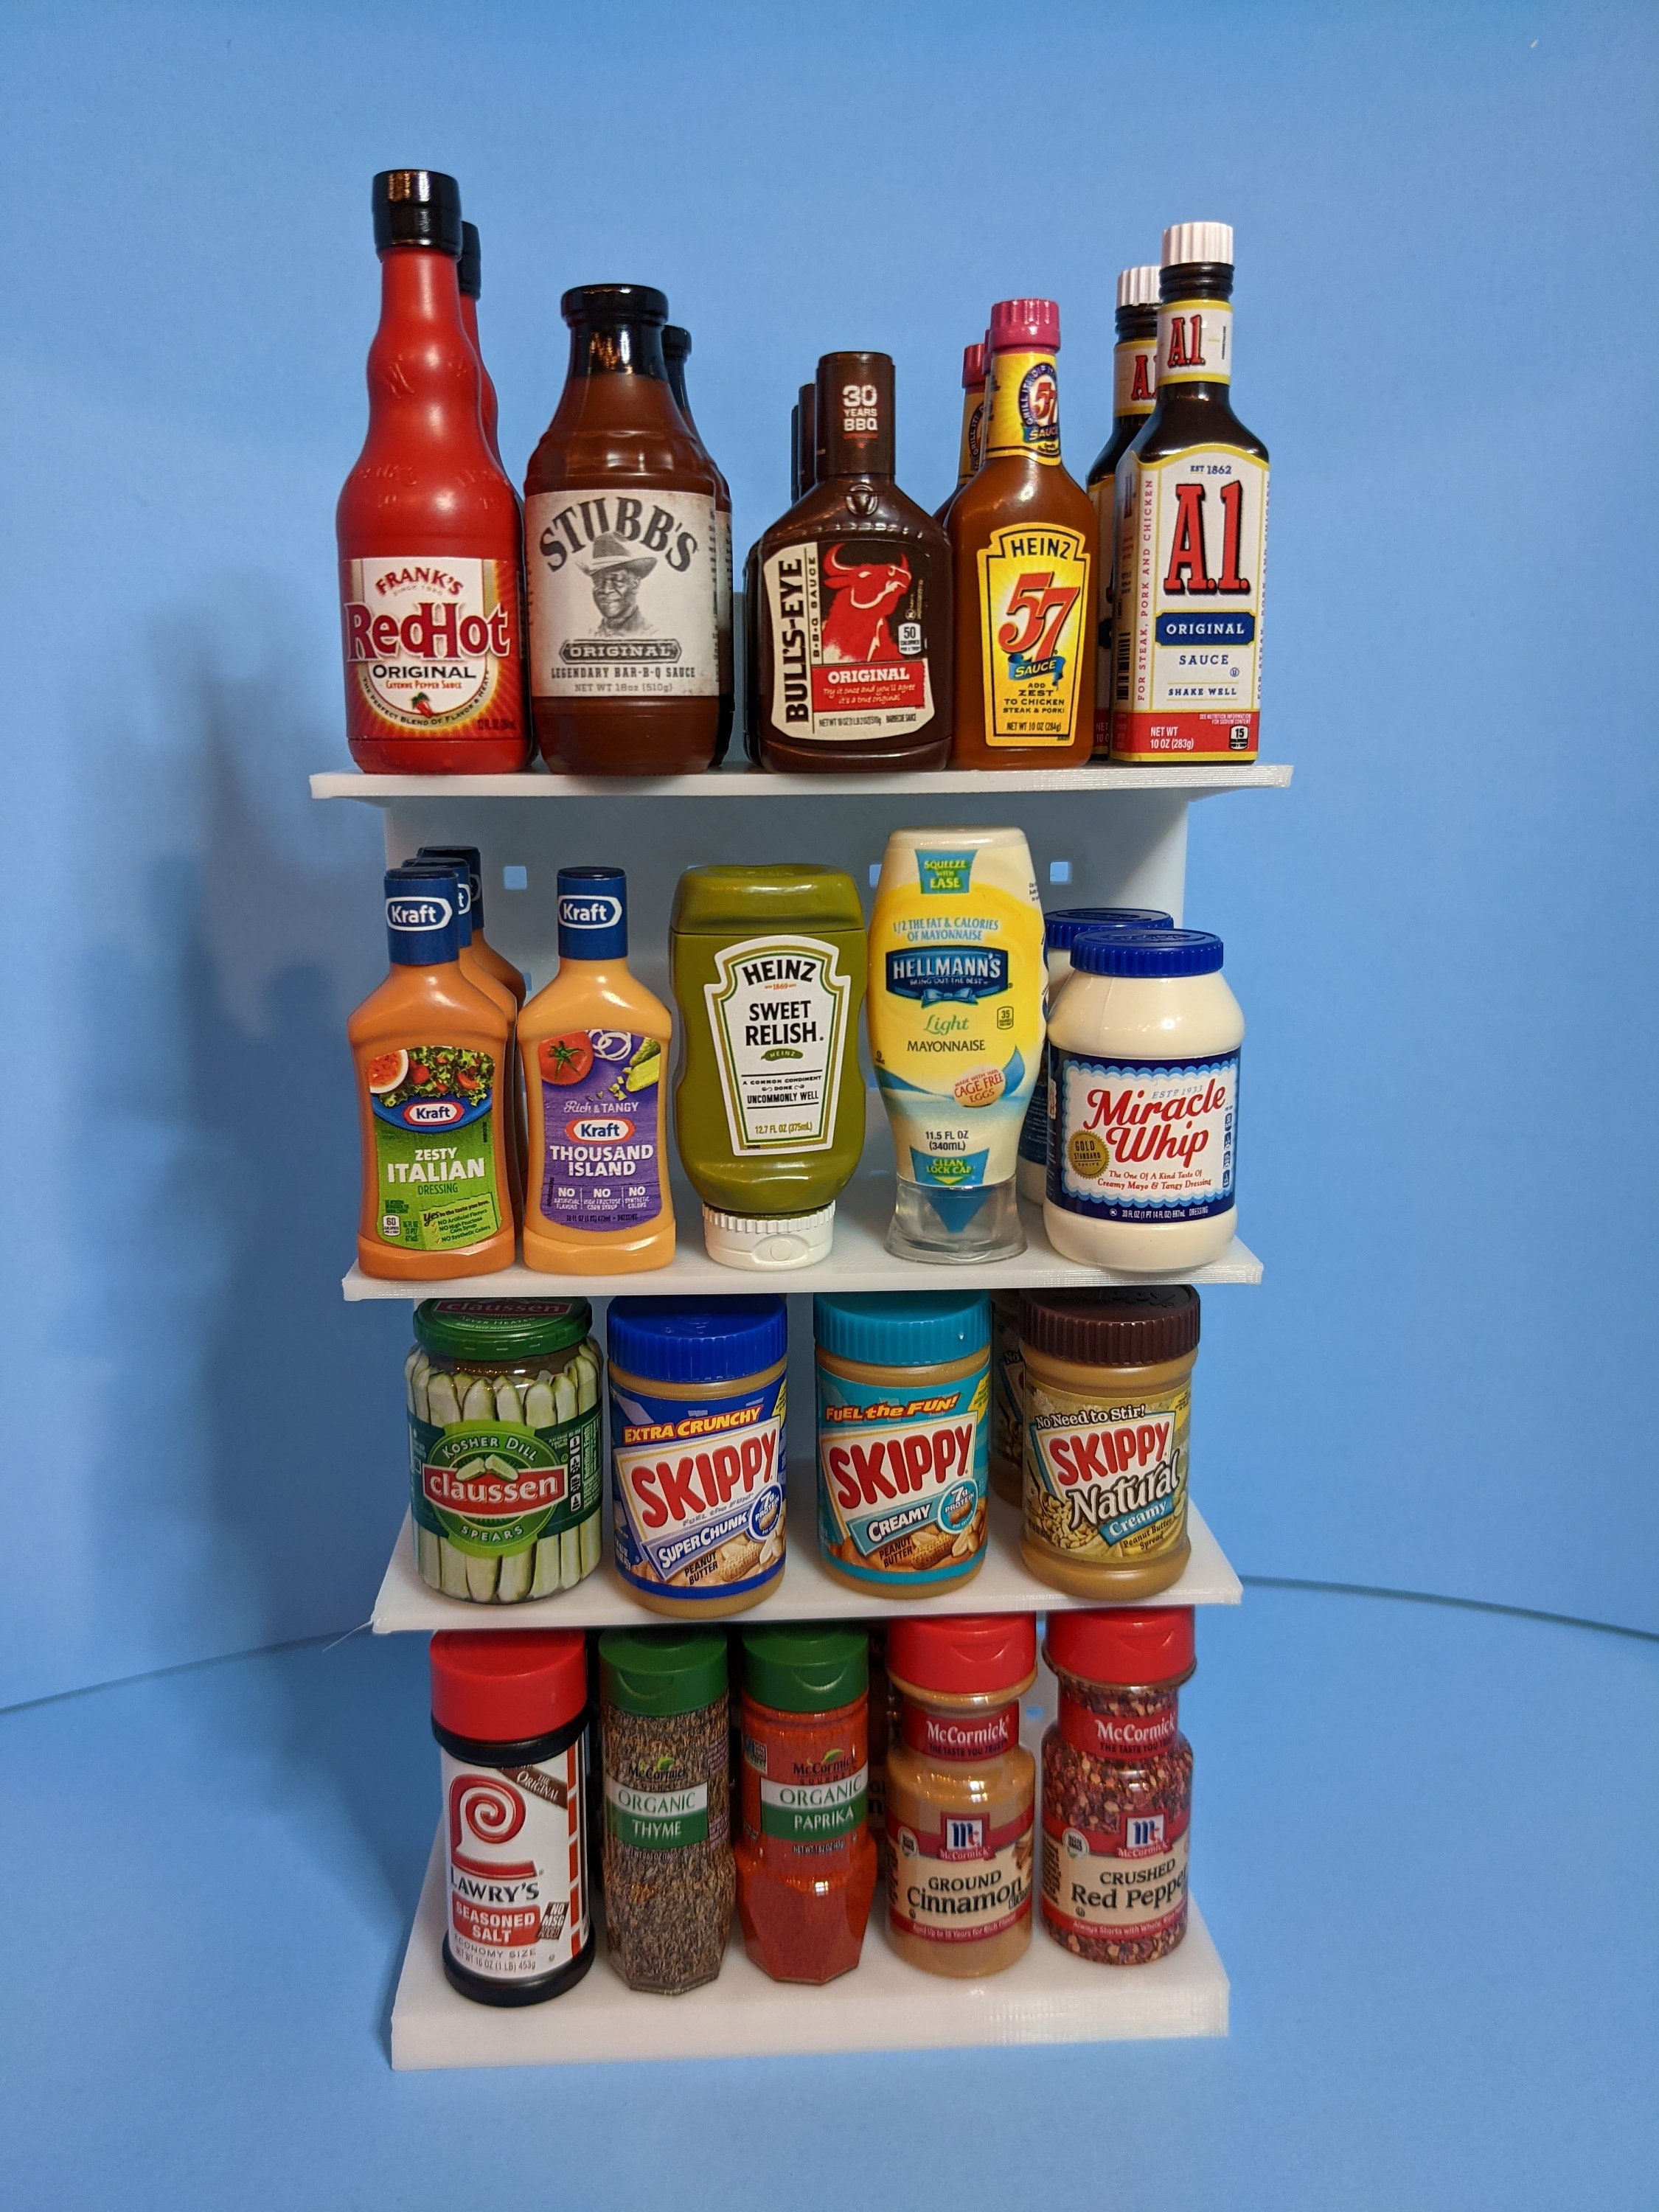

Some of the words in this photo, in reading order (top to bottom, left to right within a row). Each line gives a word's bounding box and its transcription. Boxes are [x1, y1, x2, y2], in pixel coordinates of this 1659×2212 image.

[842, 384, 877, 407] 30
[843, 408, 878, 417] YEARS
[844, 417, 878, 431] BBQ
[1206, 465, 1231, 475] 1862
[1144, 480, 1153, 541] CHICKEN
[539, 496, 699, 574] STUBB'S
[1011, 538, 1071, 559] HEINZ
[1142, 549, 1151, 575] AND
[375, 567, 464, 597] FRANK'S
[1141, 582, 1150, 617] PORK
[998, 571, 1081, 662] 57
[345, 602, 510, 661] RedHot
[903, 627, 916, 639] 50
[1166, 623, 1245, 635] ORIGINAL
[779, 558, 810, 723] BULL'S-EYE
[1138, 624, 1149, 670] STEAK,
[569, 644, 672, 658] ORIGINAL
[1179, 655, 1230, 665] SAUCE
[373, 664, 476, 678] ORIGINAL
[551, 667, 609, 679] LEGENDARY
[614, 667, 661, 679] BAR-B-Q
[666, 667, 696, 678] SAUCE
[827, 667, 911, 684] ORIGINAL
[1015, 660, 1057, 678] SAUCE
[1138, 677, 1146, 701] FOR
[1168, 688, 1203, 696] SHAKE
[1208, 688, 1237, 696] WELL
[1150, 726, 1165, 737] NET
[1166, 726, 1178, 737] WT
[1235, 728, 1245, 738] 15
[1150, 740, 1158, 749] 10
[1160, 739, 1170, 749] OZ
[1171, 738, 1194, 750] (283g)
[924, 860, 967, 869] SQUEEZE
[930, 878, 961, 888] EASE
[392, 905, 437, 923] Kraft
[563, 902, 607, 921] Kraft
[894, 921, 906, 933] 1/2
[908, 919, 925, 929] THE
[926, 917, 942, 928] FAT
[945, 918, 952, 928] &
[955, 917, 999, 931] CALORIES
[908, 931, 920, 942] OF
[922, 930, 982, 941] MAYONNAISE
[742, 959, 817, 986] HEINZ
[893, 952, 1001, 980] HELLMANN'S
[749, 1000, 811, 1021] SWEET
[1001, 1010, 1010, 1018] 35
[923, 1015, 970, 1035] Light
[769, 1050, 797, 1058] HEINZ
[907, 1040, 986, 1052] MAYONNAISE
[954, 1082, 981, 1098] CAGE
[983, 1073, 1004, 1091] FREE
[747, 1093, 798, 1104] UNCOMMONLY
[800, 1091, 818, 1101] WELL
[969, 1088, 995, 1103] EGGS
[1083, 1079, 1225, 1130] Miracle
[416, 1106, 451, 1121] Kraft
[563, 1101, 591, 1113] Rich
[594, 1105, 600, 1113] &
[601, 1102, 639, 1113] TANGY
[580, 1123, 620, 1137] Kraft
[925, 1131, 942, 1140] 11.5
[945, 1131, 955, 1140] FL
[958, 1130, 969, 1139] OZ
[550, 1144, 654, 1161] THOUSAND
[1075, 1141, 1095, 1151] GOLD
[1106, 1121, 1209, 1168] Whip
[415, 1147, 458, 1162] ZESTY
[933, 1159, 964, 1167] CLEAN
[1074, 1152, 1101, 1160] STANDARD
[387, 1158, 486, 1183] ITALIAN
[568, 1161, 636, 1176] ISLAND
[926, 1166, 950, 1174] LOCK
[952, 1166, 972, 1174] CAP
[1124, 1171, 1137, 1180] One
[1140, 1172, 1149, 1180] Of
[1178, 1171, 1193, 1179] Taste
[1194, 1169, 1203, 1178] Of
[418, 1183, 459, 1195] DRESSING
[558, 1187, 575, 1197] NO
[594, 1188, 611, 1197] NO
[629, 1186, 646, 1196] NO
[1098, 1178, 1125, 1190] Creamy
[1127, 1181, 1148, 1191] Mayo
[1161, 1181, 1183, 1190] Tangy
[1185, 1179, 1211, 1189] Dressing
[386, 1217, 397, 1225] 60
[447, 1301, 560, 1312] claussen
[827, 1405, 863, 1422] FUEL
[866, 1402, 903, 1419] the
[907, 1394, 958, 1416] FUN!
[1035, 1416, 1050, 1429] No
[1051, 1412, 1088, 1427] Need
[1091, 1411, 1108, 1422] to
[1110, 1405, 1146, 1420] Stir!
[625, 1426, 674, 1443] EXTRA
[678, 1407, 762, 1437] CRUNCHY
[443, 1437, 499, 1460] KOSHER
[506, 1437, 538, 1461] DILL
[1049, 1421, 1170, 1486] SKIPPY
[829, 1423, 973, 1509] SKIPPY
[430, 1472, 557, 1503] claussen
[631, 1429, 777, 1528] SKIPPY
[1068, 1449, 1180, 1530] Natural
[755, 1495, 779, 1521] PROTEIN
[945, 1492, 974, 1513] PROTEIN
[867, 1503, 933, 1543] CREAMY
[1109, 1500, 1166, 1537] Creamy
[461, 1526, 523, 1541] SPEARS
[1122, 1530, 1150, 1548] Peanut
[1151, 1518, 1172, 1534] Butter
[1139, 1533, 1164, 1551] Spread
[880, 1538, 911, 1559] PEANUT
[883, 1548, 913, 1568] BUTTER
[684, 1551, 717, 1576] PEANUT
[689, 1560, 718, 1585] BUTTER
[927, 1717, 1007, 1745] McCormick
[1095, 1715, 1174, 1743] McCormick
[793, 1756, 856, 1775] McCormick
[517, 1770, 559, 1801] ORIGINAL
[780, 1774, 862, 1806] ORGANIC
[619, 1790, 695, 1813] ORGANIC
[794, 1806, 854, 1830] PAPRIKA
[632, 1819, 681, 1839] THYME
[939, 1843, 988, 1860] McCormick
[1117, 1841, 1169, 1858] McCormick
[928, 1869, 1001, 1892] GROUND
[1099, 1857, 1175, 1885] CRUSHED
[451, 1865, 540, 1902] LAWRY'S
[907, 1876, 1021, 1914] Cinnamon
[1071, 1881, 1118, 1910] Red
[456, 1901, 535, 1928] SEASONED
[551, 1903, 566, 1915] NO
[543, 1915, 566, 1926] MSG
[472, 1924, 512, 1943] SALT
[454, 1933, 504, 1958] ECONOMY
[509, 1948, 537, 1958] SIZE
